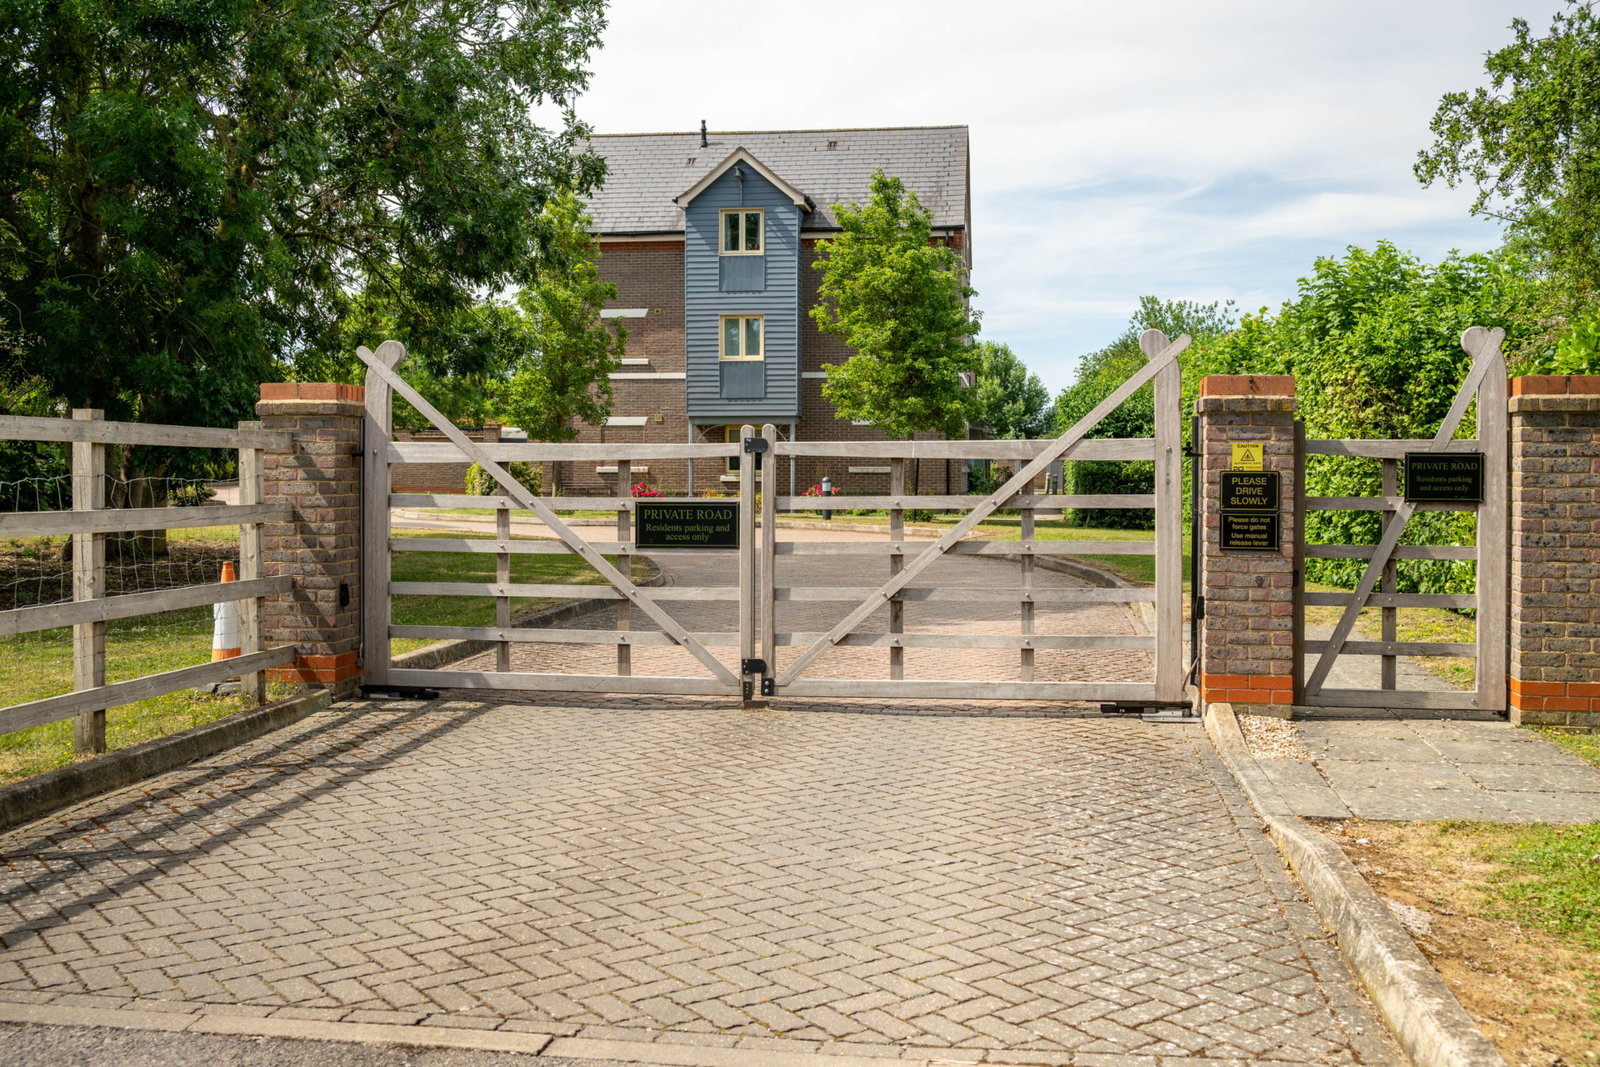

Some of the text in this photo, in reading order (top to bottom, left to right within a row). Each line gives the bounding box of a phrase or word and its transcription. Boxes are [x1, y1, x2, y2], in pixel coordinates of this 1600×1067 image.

[1411, 462, 1478, 471] PRIVATE ROAD
[1231, 477, 1267, 485] PLEASE
[1416, 475, 1473, 484] Residents parking
[1235, 487, 1263, 495] DRIVE
[1454, 484, 1469, 493] only
[1230, 497, 1268, 505] SLOWLY
[644, 509, 733, 520] PRIVATE ROAD
[645, 523, 730, 533] Residents parking and
[691, 533, 710, 543] only
